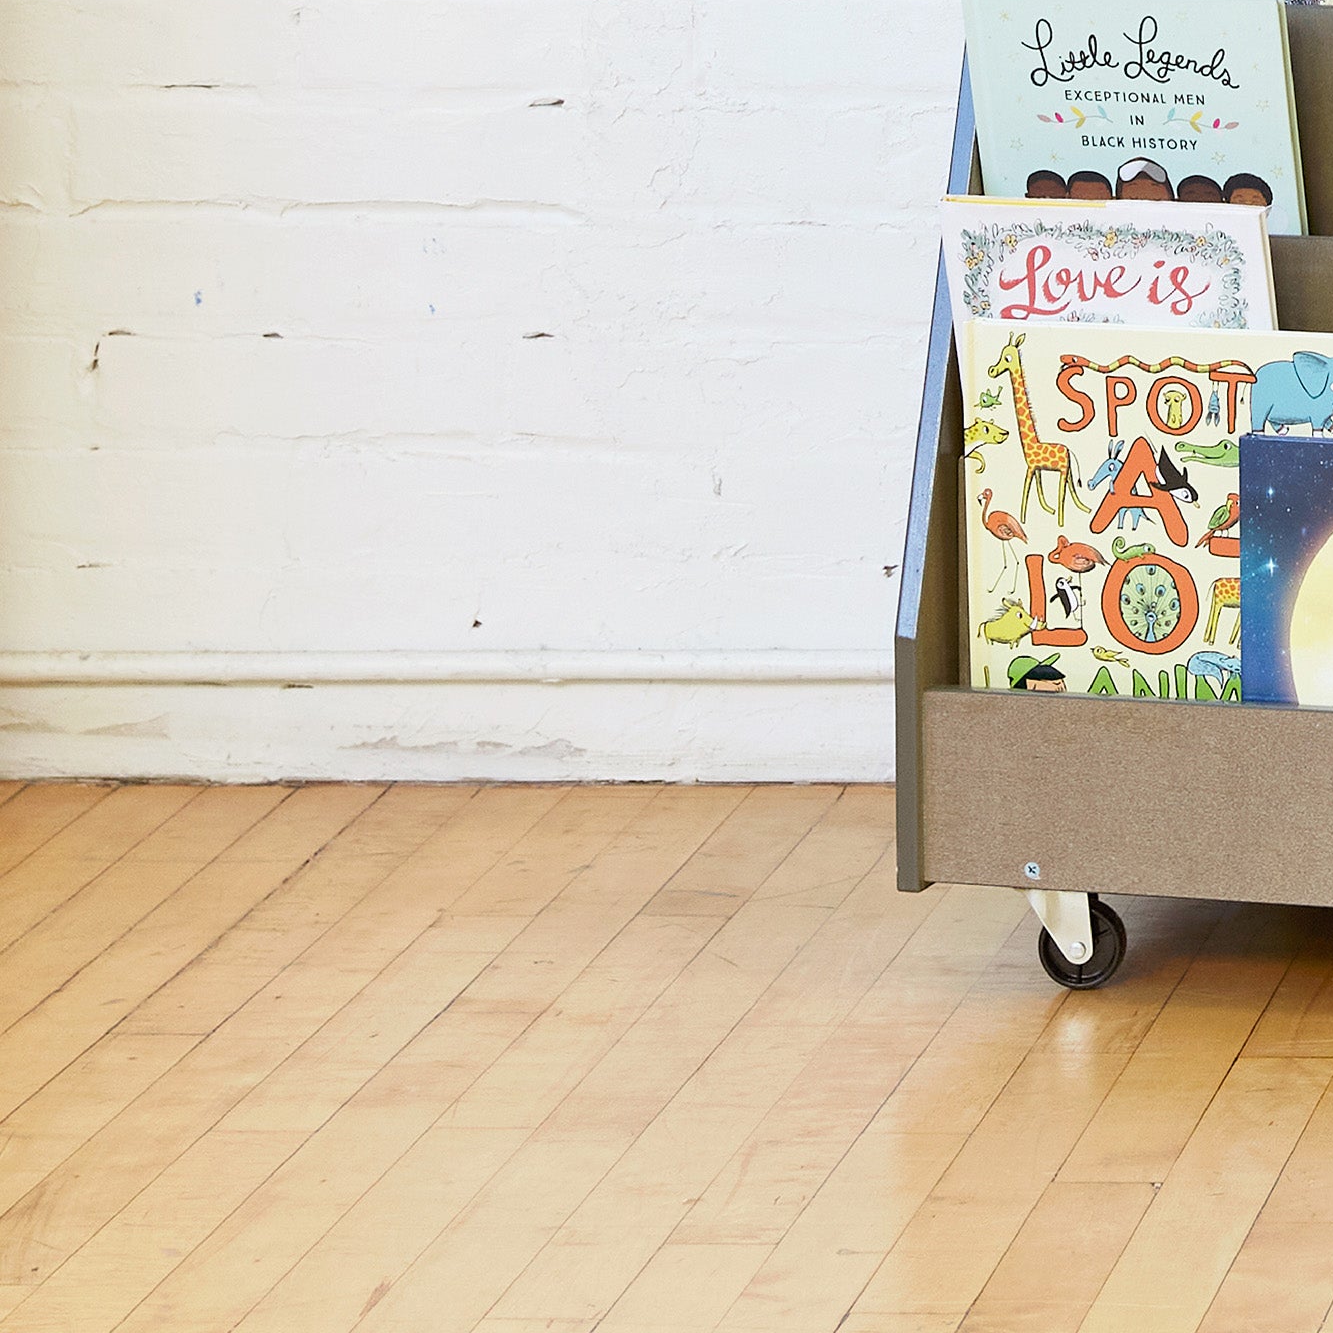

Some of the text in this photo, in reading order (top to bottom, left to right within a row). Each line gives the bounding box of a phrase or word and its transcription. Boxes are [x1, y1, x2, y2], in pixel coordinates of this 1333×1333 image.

[1021, 15, 1240, 89] Little Legends
[1064, 89, 1206, 105] EXCEPTIONAL MEN
[1129, 114, 1145, 126] IN
[1081, 135, 1199, 151] BLACK HISTORY
[999, 245, 1212, 319] Love is
[1056, 365, 1257, 437] SPOT
[1089, 436, 1189, 547] A
